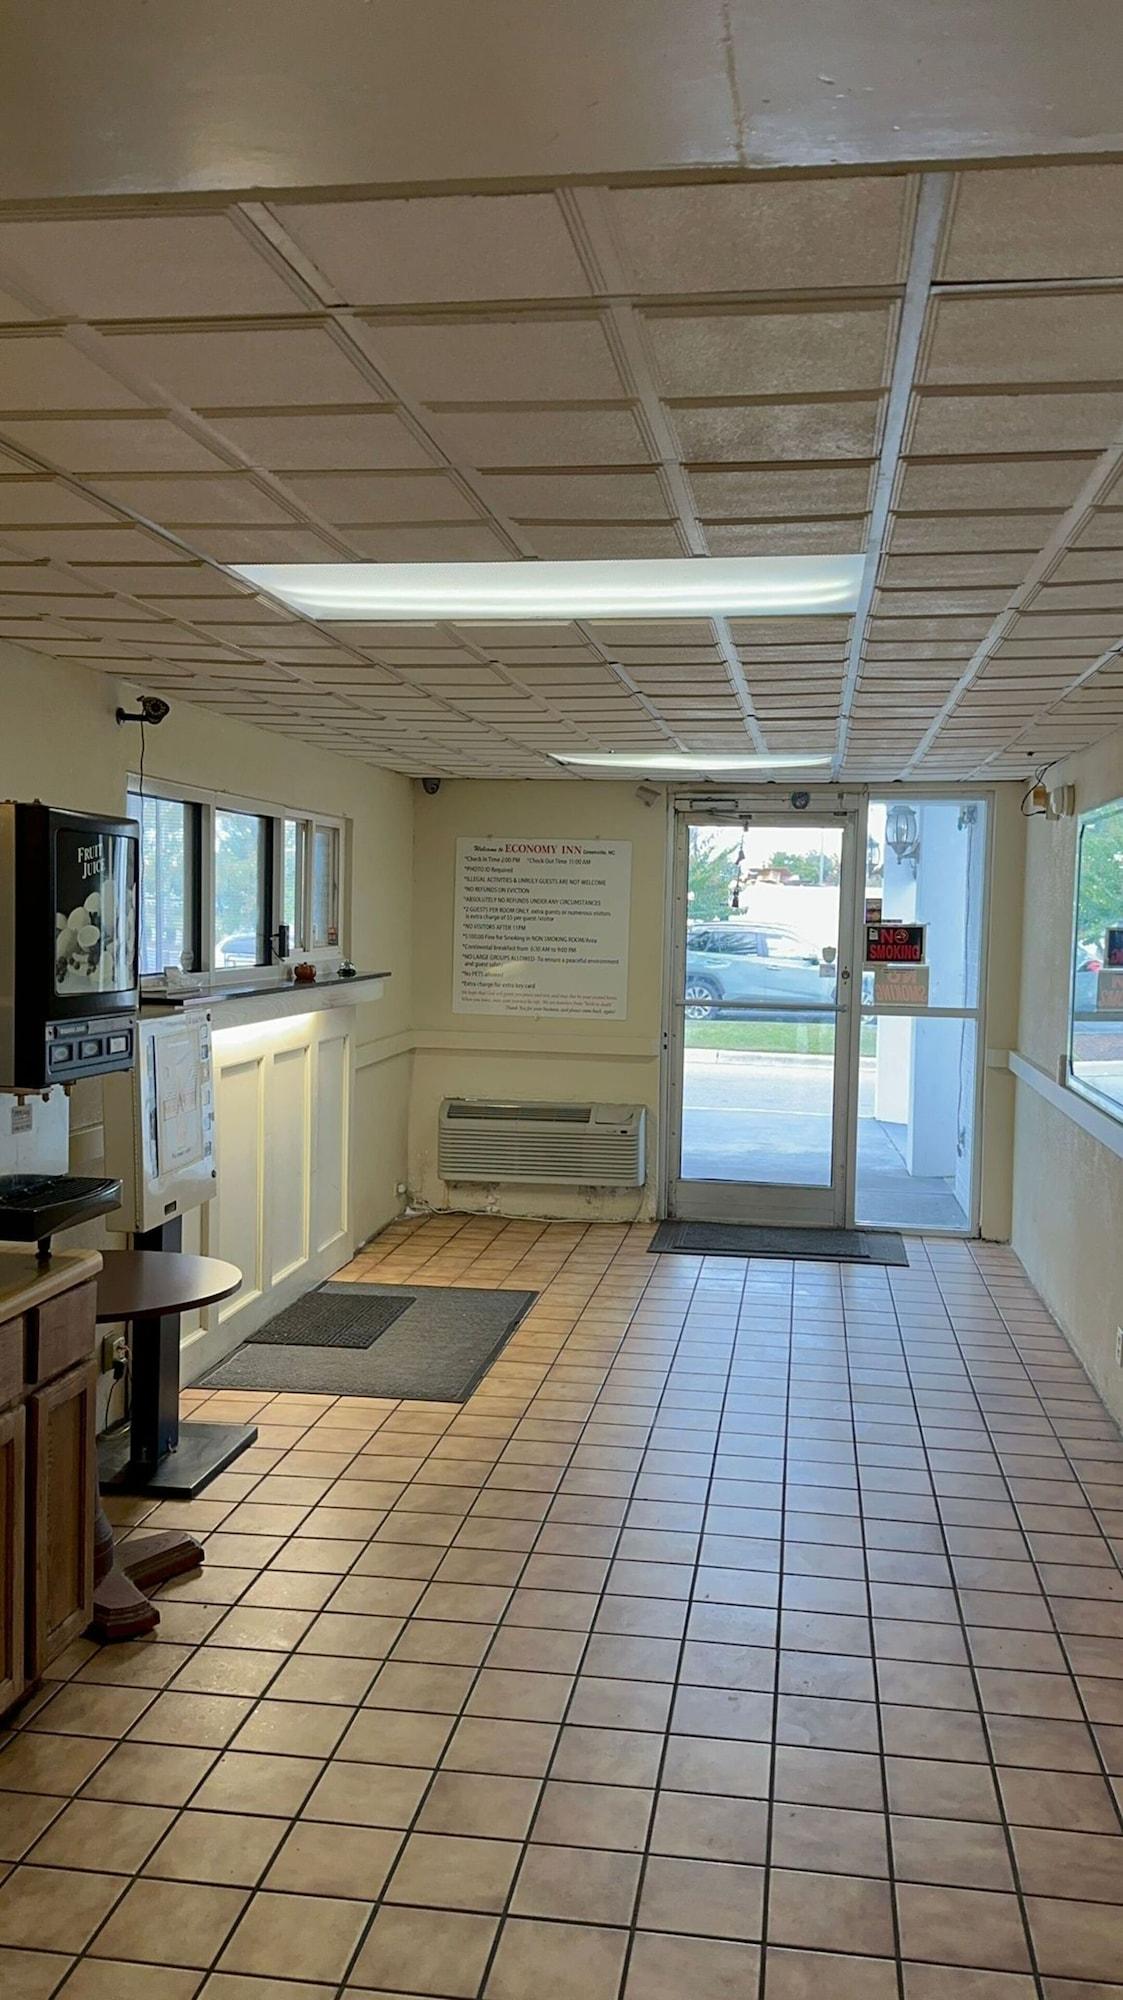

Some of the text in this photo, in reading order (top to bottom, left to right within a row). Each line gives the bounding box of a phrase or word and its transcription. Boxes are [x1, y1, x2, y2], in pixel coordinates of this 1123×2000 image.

[77, 843, 103, 863] FRUIT
[505, 844, 557, 854] ECONOMY
[560, 845, 582, 854] INN
[82, 858, 105, 879] JUICE
[880, 928, 909, 944] NO
[870, 945, 920, 959] SMOKING
